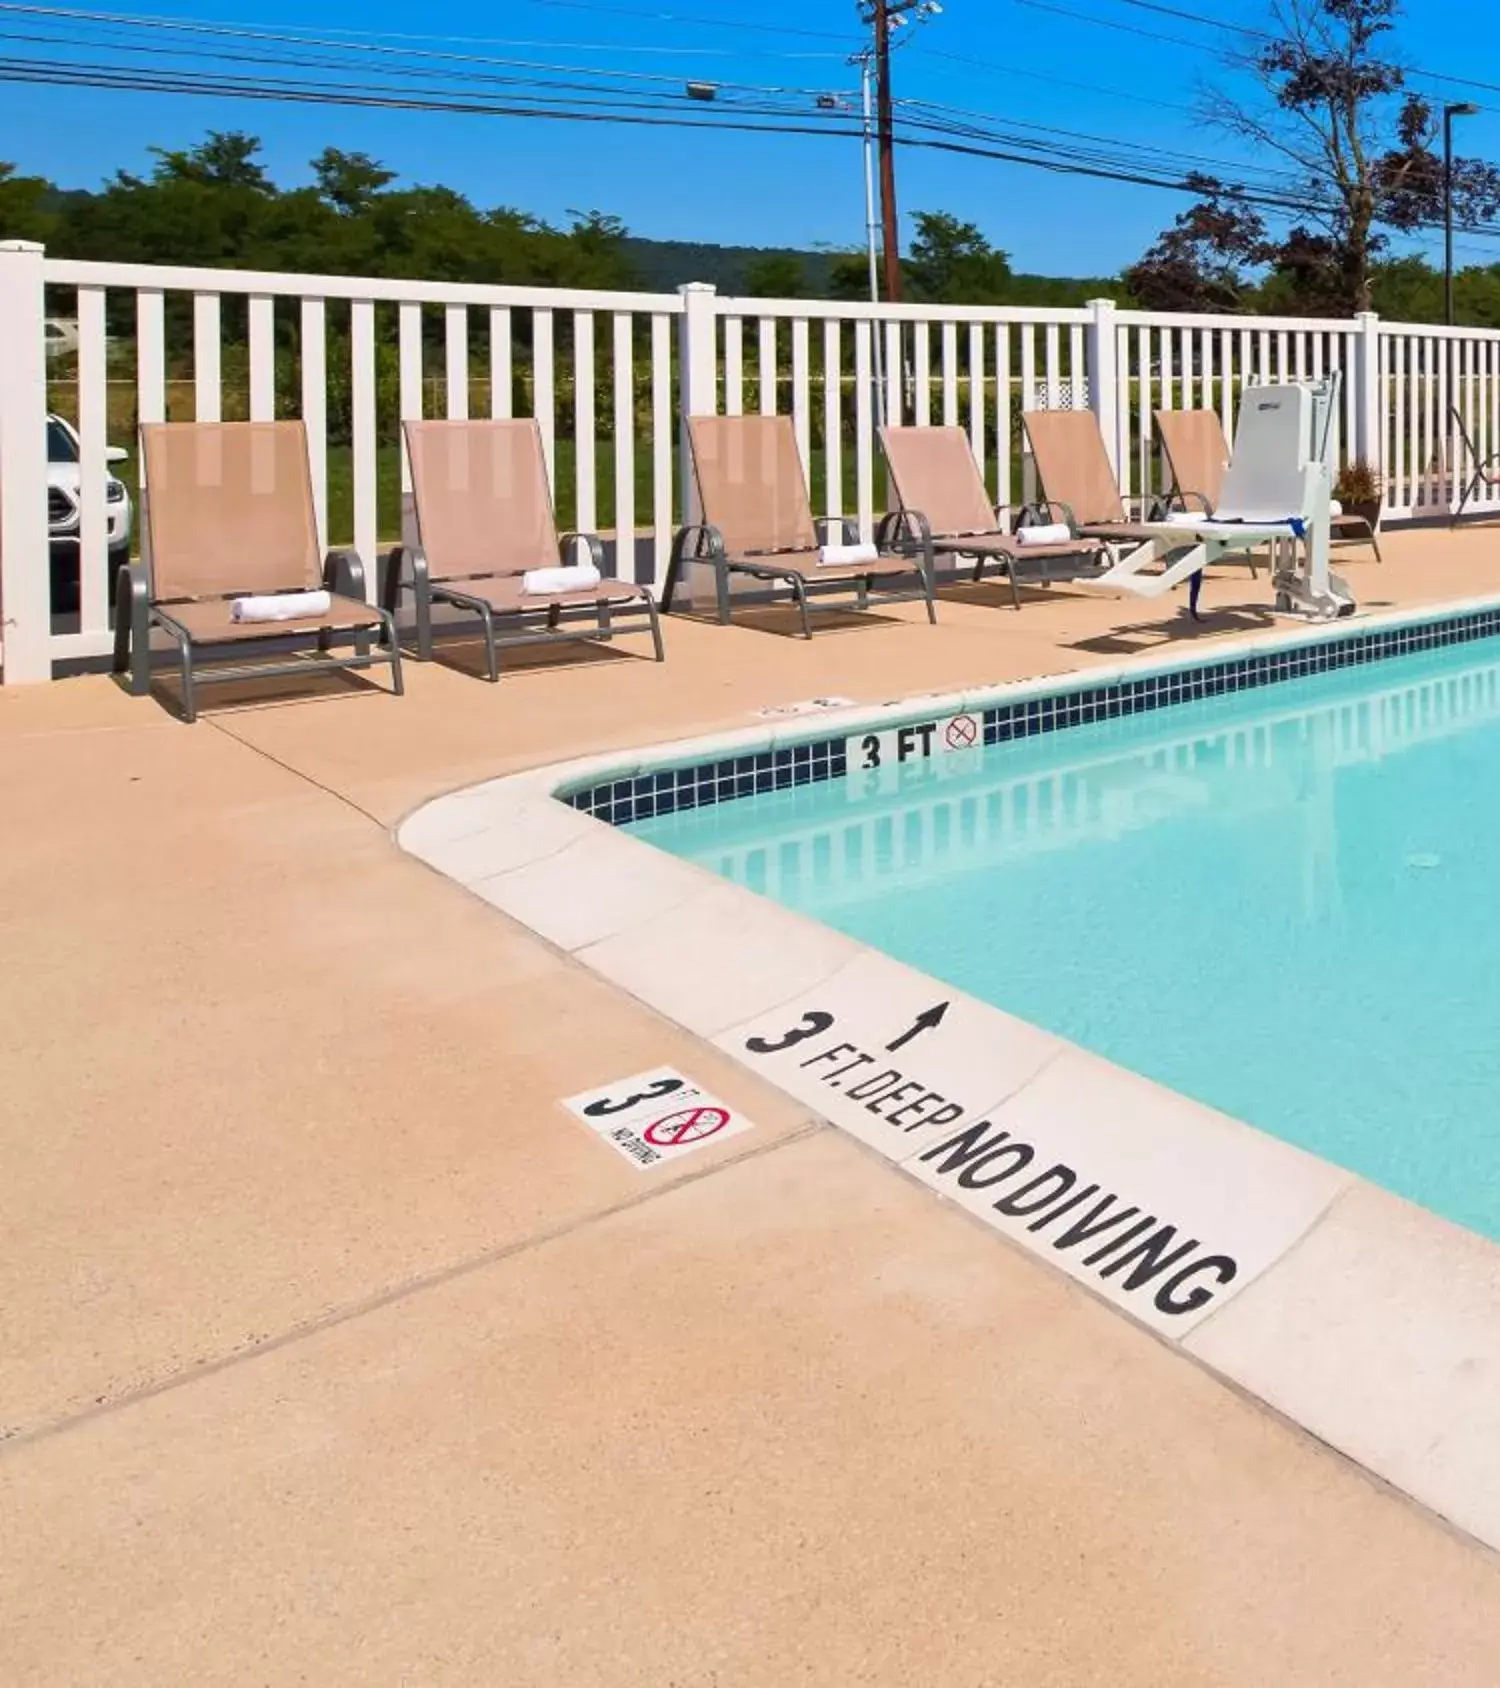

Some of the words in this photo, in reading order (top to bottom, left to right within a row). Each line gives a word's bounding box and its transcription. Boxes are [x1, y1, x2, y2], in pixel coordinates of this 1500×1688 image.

[861, 735, 881, 769] 3
[897, 723, 937, 762] FT
[583, 1080, 684, 1116] 3
[746, 1012, 834, 1053] 3
[846, 1070, 963, 1132] DEEP
[919, 1121, 1035, 1189] NO
[993, 1164, 1237, 1315] DIVING
